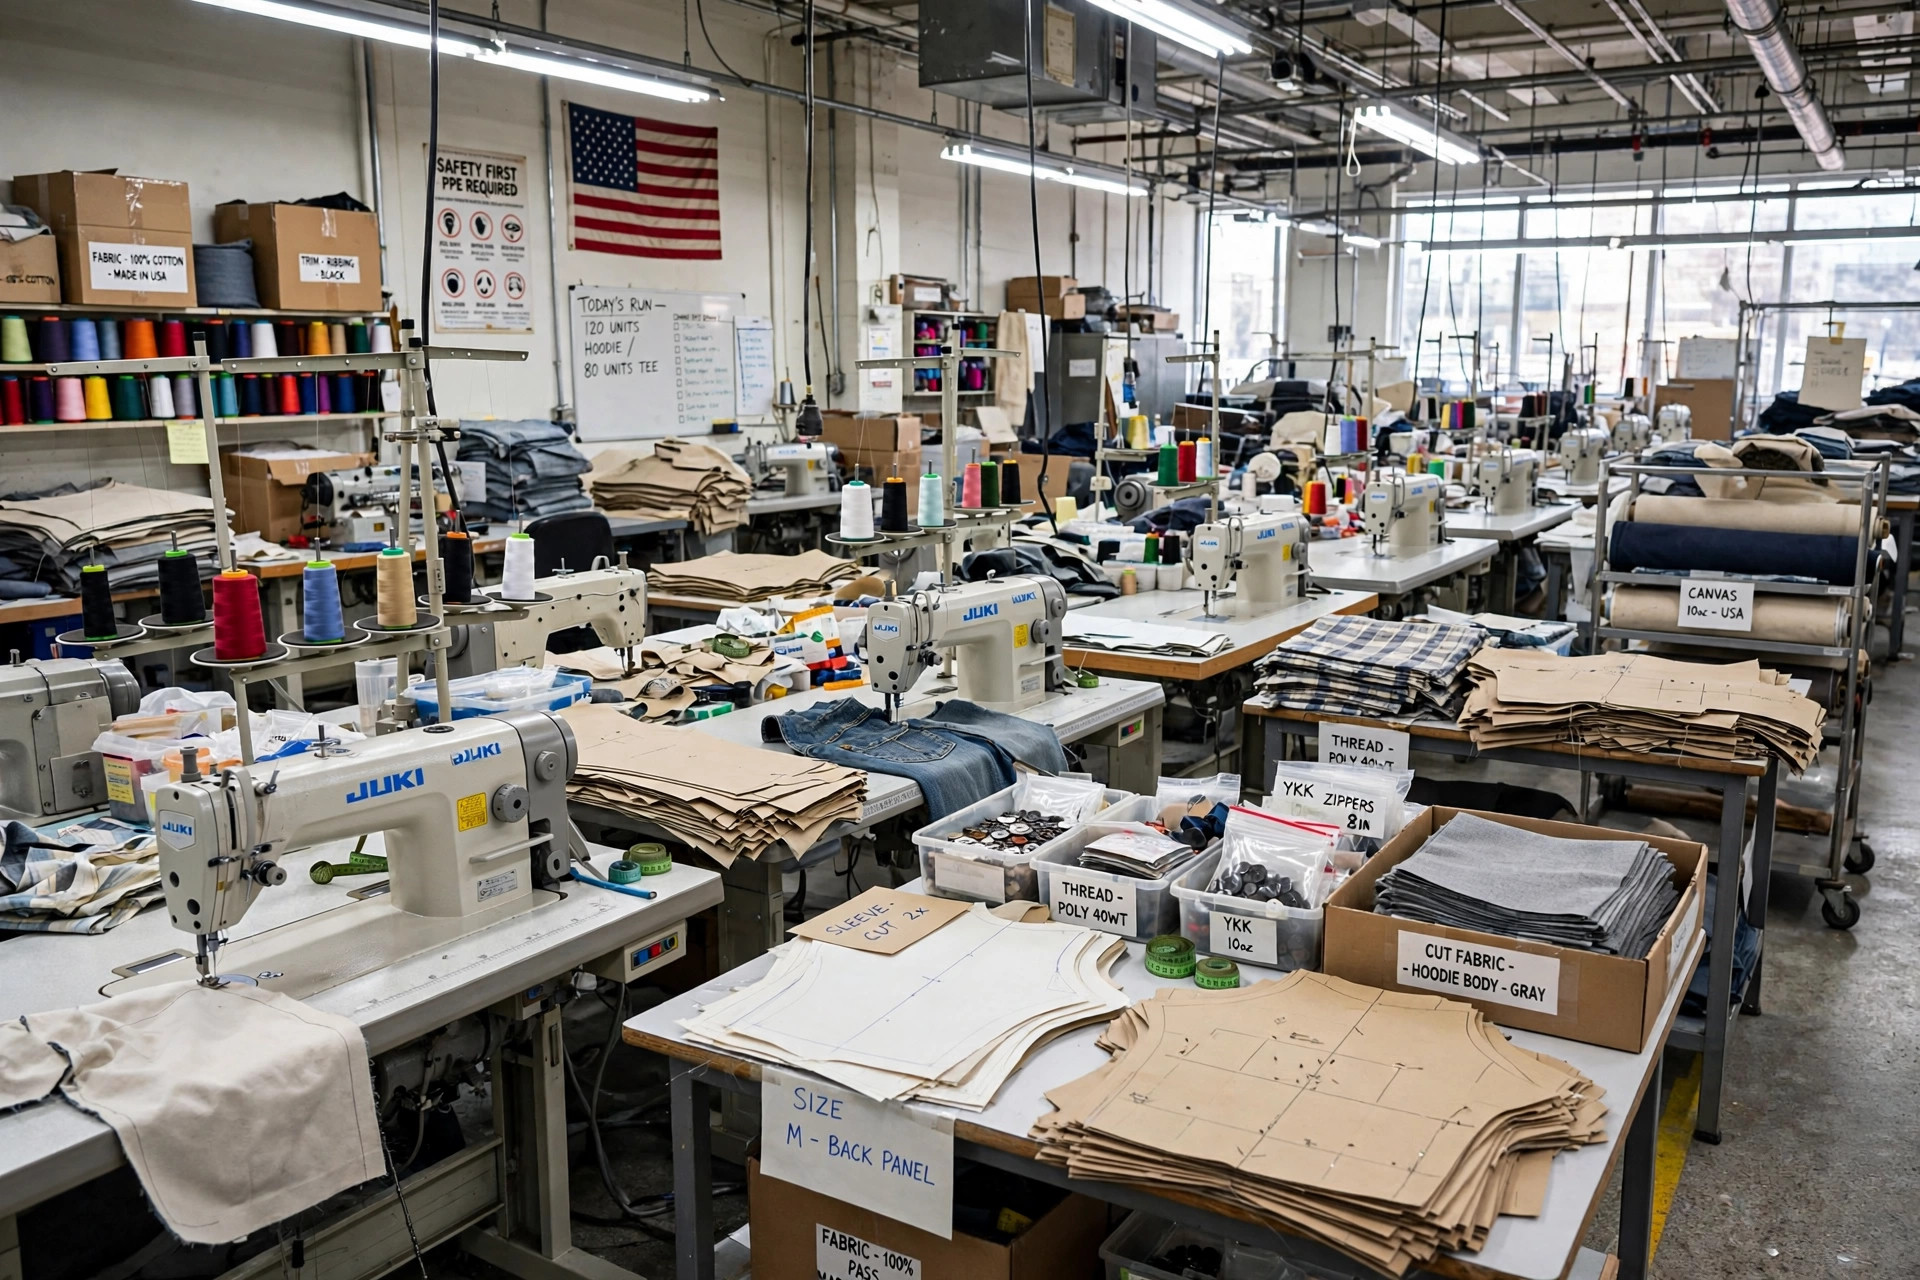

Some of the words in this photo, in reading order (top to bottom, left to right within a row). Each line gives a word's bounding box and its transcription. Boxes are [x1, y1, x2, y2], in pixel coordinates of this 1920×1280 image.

[437, 157, 482, 177] SAFETY
[486, 164, 517, 181] FIRST
[442, 176, 463, 191] PPE
[466, 179, 518, 198] REQUIRED
[92, 252, 122, 264] FABRIC
[130, 253, 150, 265] 100%
[152, 255, 184, 266] COTTON
[301, 256, 319, 265] TRIM
[113, 271, 137, 280] MADE
[139, 272, 148, 280] IN
[150, 271, 167, 281] USA
[320, 270, 345, 280] BLACK
[577, 296, 624, 314] TODAY'S
[631, 297, 652, 311] RUN
[585, 321, 604, 335] 120
[610, 321, 640, 334] UNITS
[585, 341, 622, 356] HOODIE
[584, 363, 598, 378] 80
[604, 362, 633, 376] UNITS
[638, 360, 658, 373] TEE
[1688, 587, 1737, 602] CANVAS
[963, 603, 999, 622] JUKI
[1721, 607, 1744, 620] USA
[874, 624, 898, 633] JUKI
[1331, 734, 1384, 753] THREAD
[346, 767, 425, 804] JUKI
[1283, 781, 1314, 799] YKK
[1323, 793, 1374, 814] ZIPPERS
[162, 821, 192, 836] JUKI
[1062, 882, 1114, 903] THREAD
[825, 904, 889, 936] SLEEVE
[1058, 901, 1089, 920] POLY
[1093, 909, 1128, 927] 40WT
[864, 920, 898, 941] CUT
[1224, 916, 1252, 934] YKK
[1228, 937, 1253, 953] 10oz
[1425, 943, 1452, 961] CUT
[1456, 949, 1506, 972] FABRIC
[1412, 963, 1460, 985] HOODIE
[1464, 973, 1499, 992] BODY
[1510, 983, 1546, 1002] GRAY
[793, 1087, 843, 1120] SIZE
[787, 1123, 802, 1148] M
[828, 1134, 873, 1166] BACK
[882, 1150, 935, 1186] PANEL
[822, 1228, 870, 1260] FABRIC
[883, 1251, 914, 1277] 100%
[848, 1259, 880, 1280] PASS
